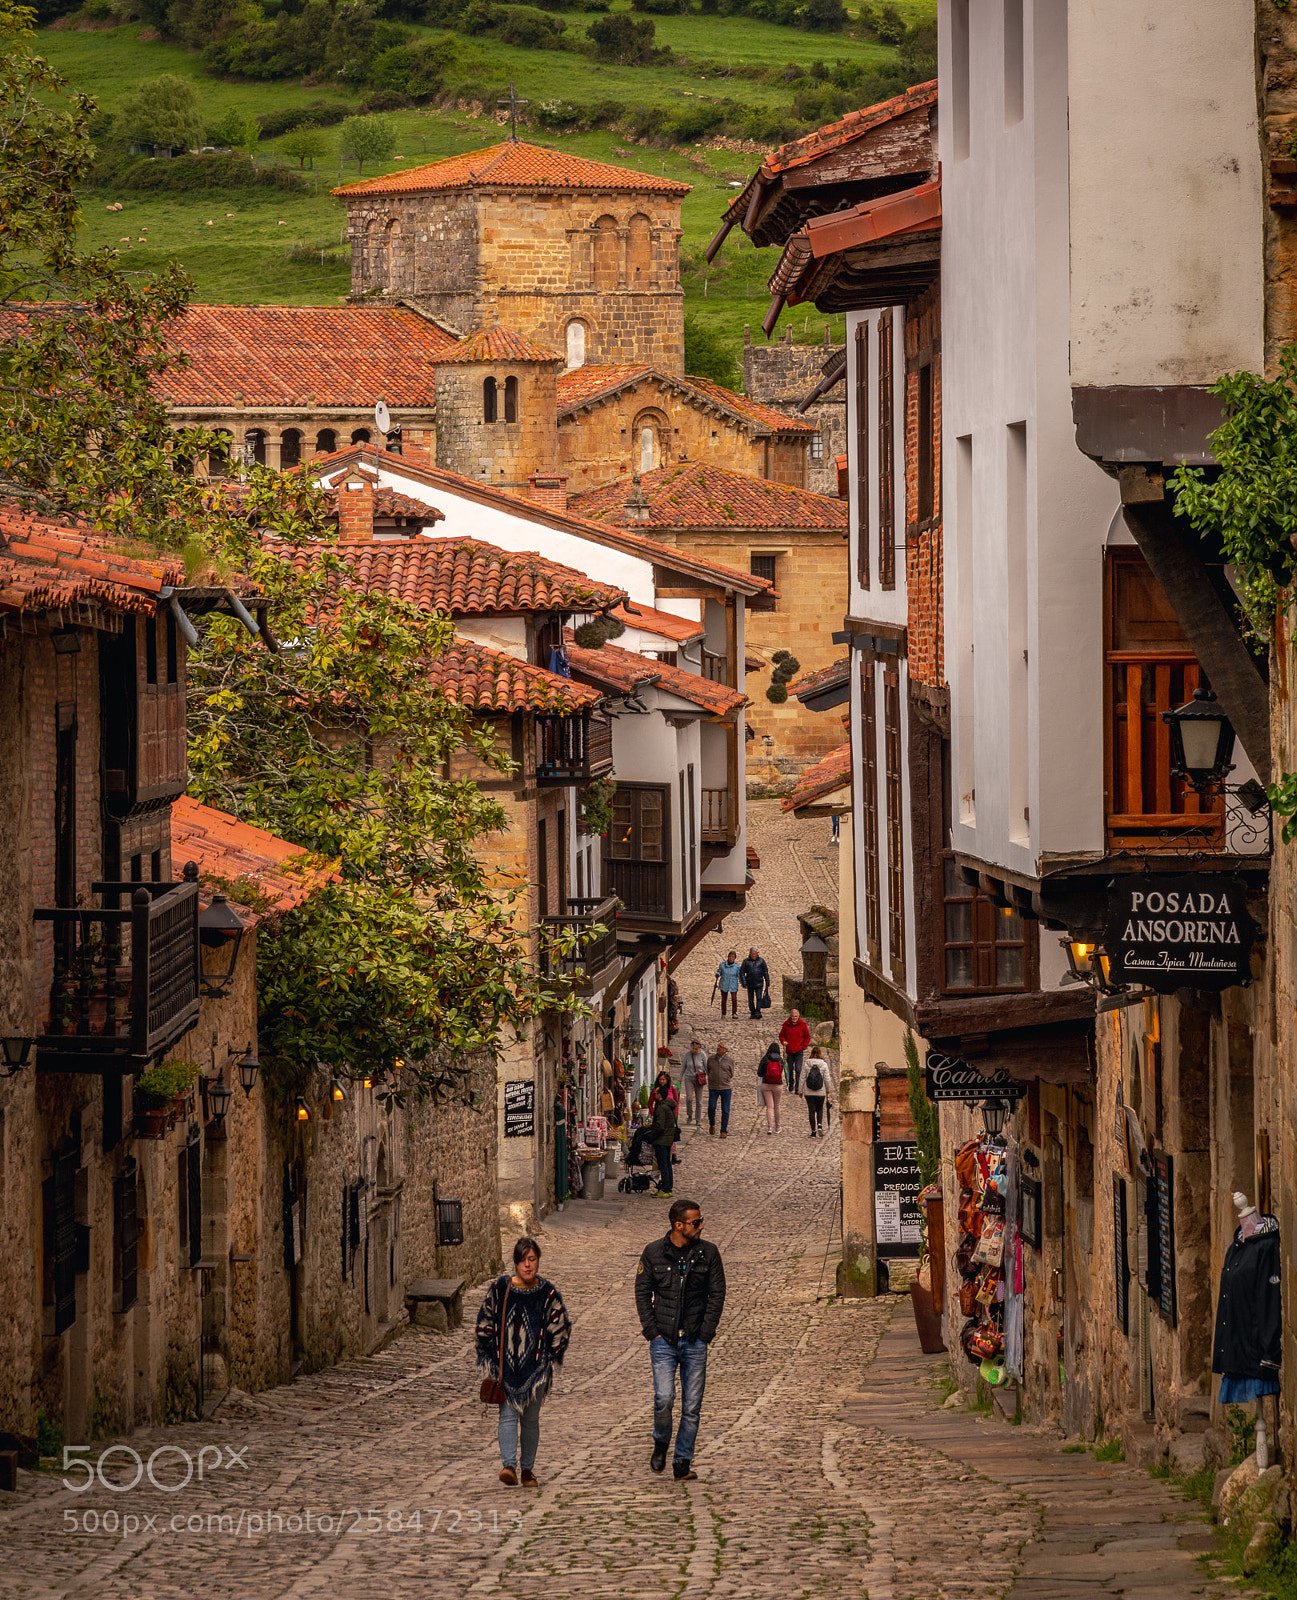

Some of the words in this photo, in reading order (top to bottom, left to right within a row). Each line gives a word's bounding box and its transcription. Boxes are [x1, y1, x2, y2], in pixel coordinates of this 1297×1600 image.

[1131, 891, 1232, 915] POSADA
[1121, 919, 1241, 944] ANSORENA
[1124, 950, 1155, 967] Casona
[1189, 951, 1237, 968] Montañesa
[883, 1145, 904, 1161] El
[877, 1166, 909, 1175] SOMOS
[883, 1183, 920, 1191] PRECIOS
[900, 1196, 911, 1204] DE
